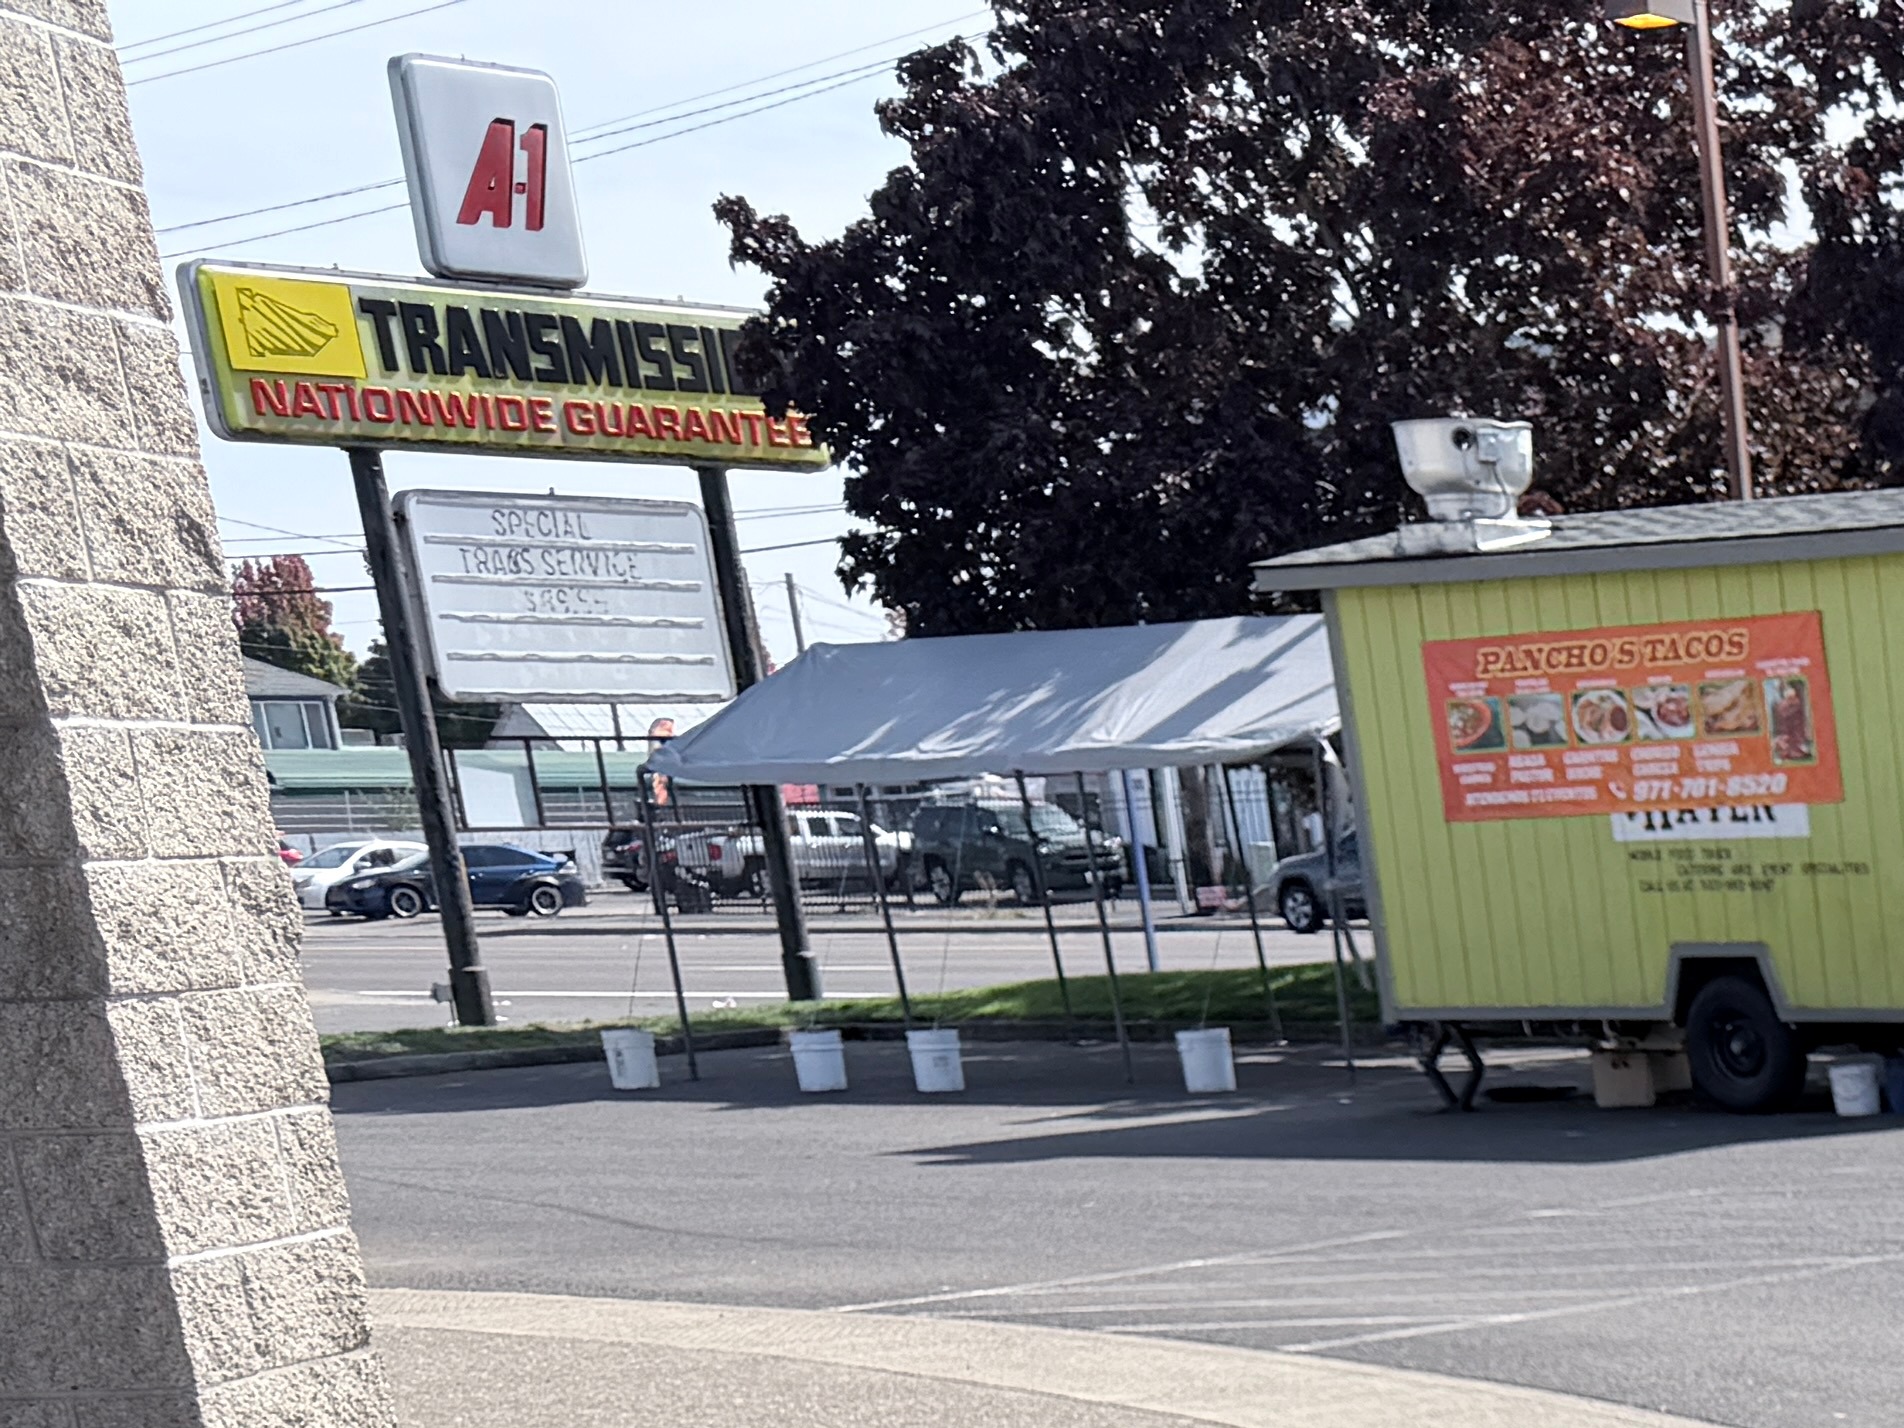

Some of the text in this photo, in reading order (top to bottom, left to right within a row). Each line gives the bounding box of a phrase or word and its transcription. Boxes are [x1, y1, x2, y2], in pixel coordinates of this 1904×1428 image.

[250, 378, 557, 433] NATIONWIDE
[491, 508, 592, 540] SPECIAL
[1643, 628, 1749, 667] TACOS
